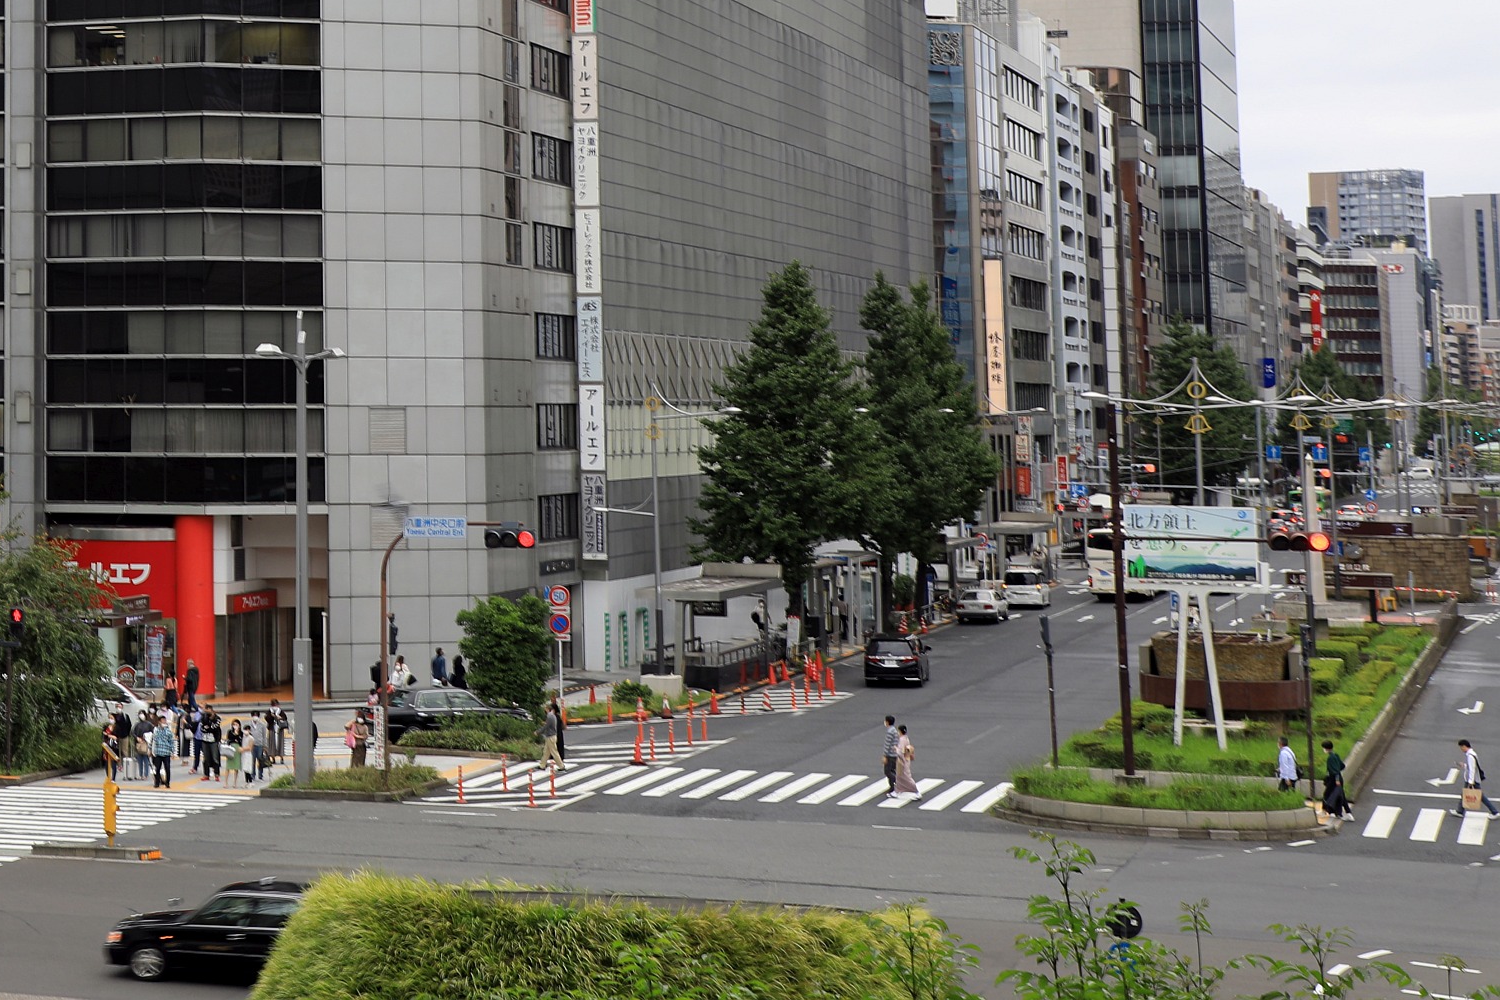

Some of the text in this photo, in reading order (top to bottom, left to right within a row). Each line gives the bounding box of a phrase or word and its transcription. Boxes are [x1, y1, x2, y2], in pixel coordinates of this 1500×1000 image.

[578, 39, 591, 115] アールエフ
[586, 126, 597, 157] 八重洲
[577, 126, 587, 200] ヤヨイクリニック
[590, 316, 599, 353] 株式会社
[585, 388, 599, 466] アールエフ
[594, 475, 604, 506] 八重洲
[405, 518, 465, 529] 八重洲中央口前
[583, 475, 596, 553] ヤヨイクリニック
[1127, 510, 1197, 531] 北方領土
